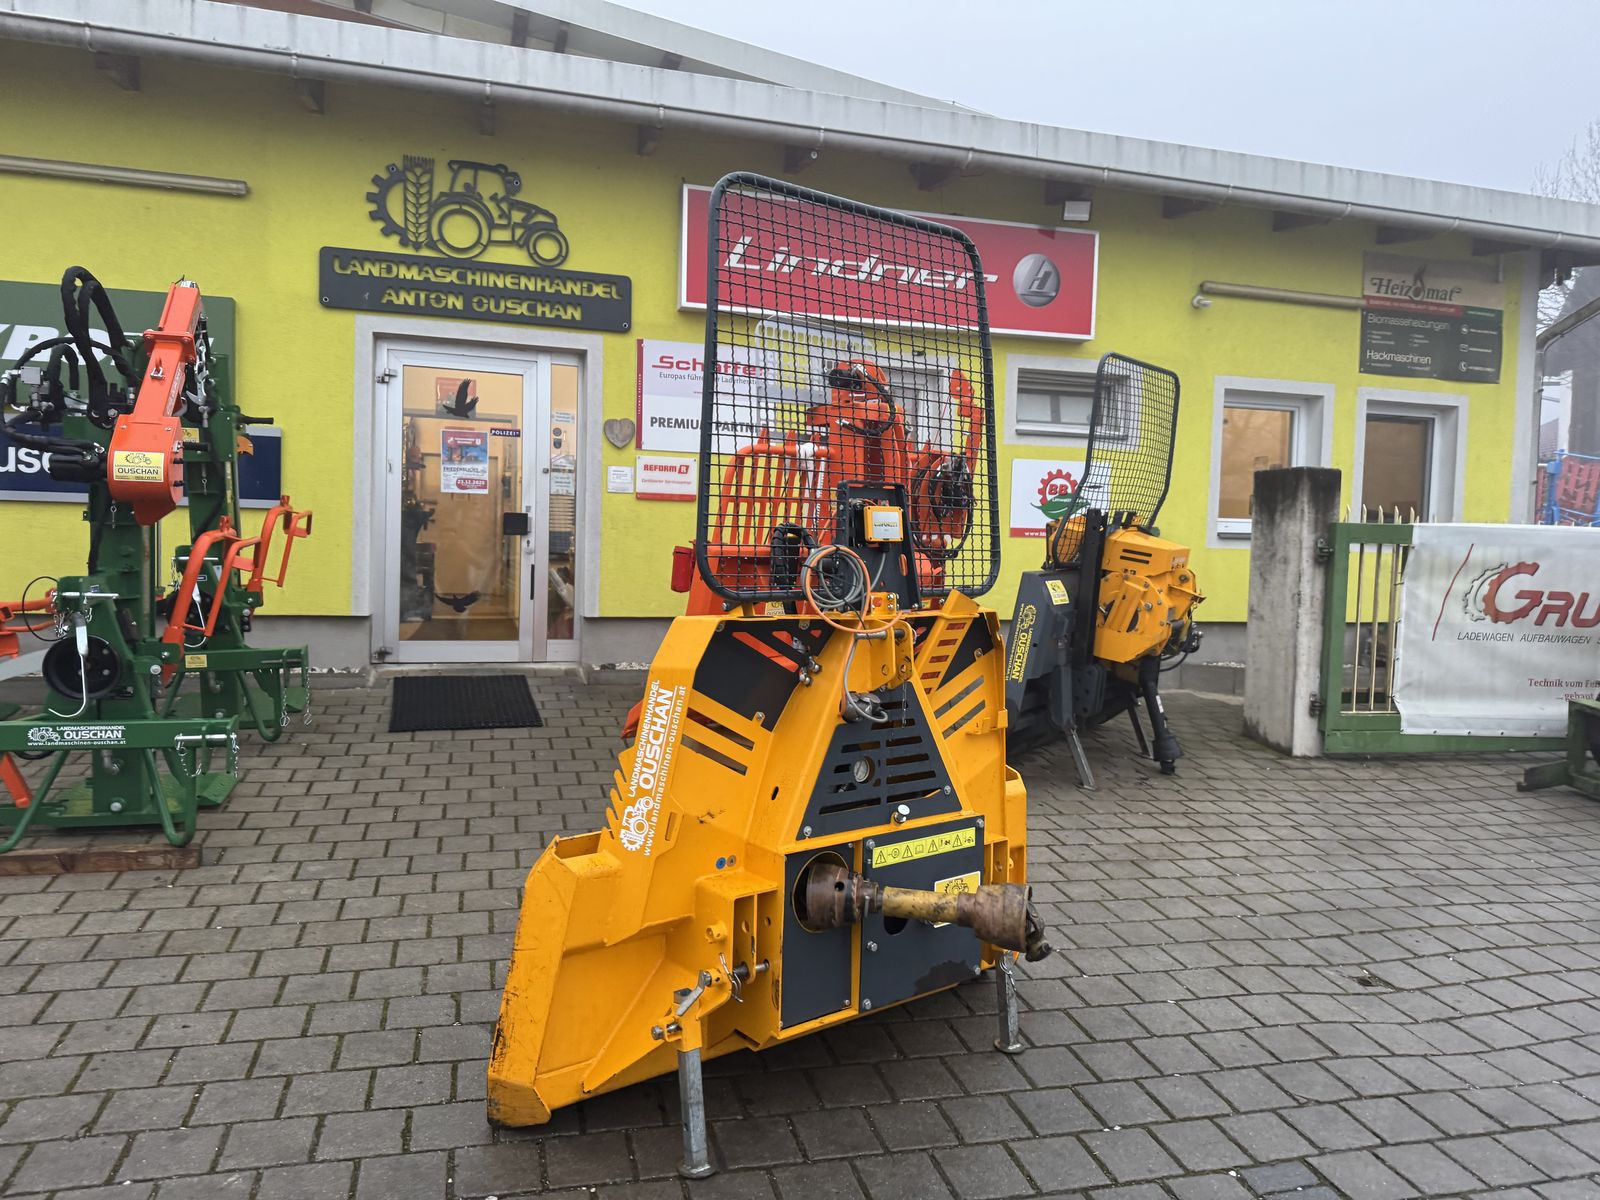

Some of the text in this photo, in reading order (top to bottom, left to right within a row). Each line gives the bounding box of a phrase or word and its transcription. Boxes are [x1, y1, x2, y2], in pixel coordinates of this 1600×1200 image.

[724, 236, 998, 290] Lindner
[333, 255, 623, 300] LANDMASCHINENHANDEL
[381, 288, 582, 321] ANTON OUSCHAN
[1366, 350, 1432, 365] Hackmaschinen
[659, 372, 686, 381] Europas
[650, 416, 702, 431] PREMIU
[117, 467, 159, 476] OUSCHAN
[643, 464, 677, 473] REFORM
[1048, 483, 1069, 496] BB
[1457, 632, 1514, 642] LADEWAGEN
[1520, 634, 1592, 644] AUFBAUWAGEN
[1011, 632, 1028, 680] OUSCHAN
[1528, 678, 1563, 687] Technik
[1565, 680, 1583, 688] vom
[63, 730, 122, 739] OUSCHAN
[628, 679, 660, 798] LANDMASCHINENHANDEL
[638, 687, 674, 791] OUSCHAN
[643, 685, 687, 857] www.landmaschinen-ouschan.at
